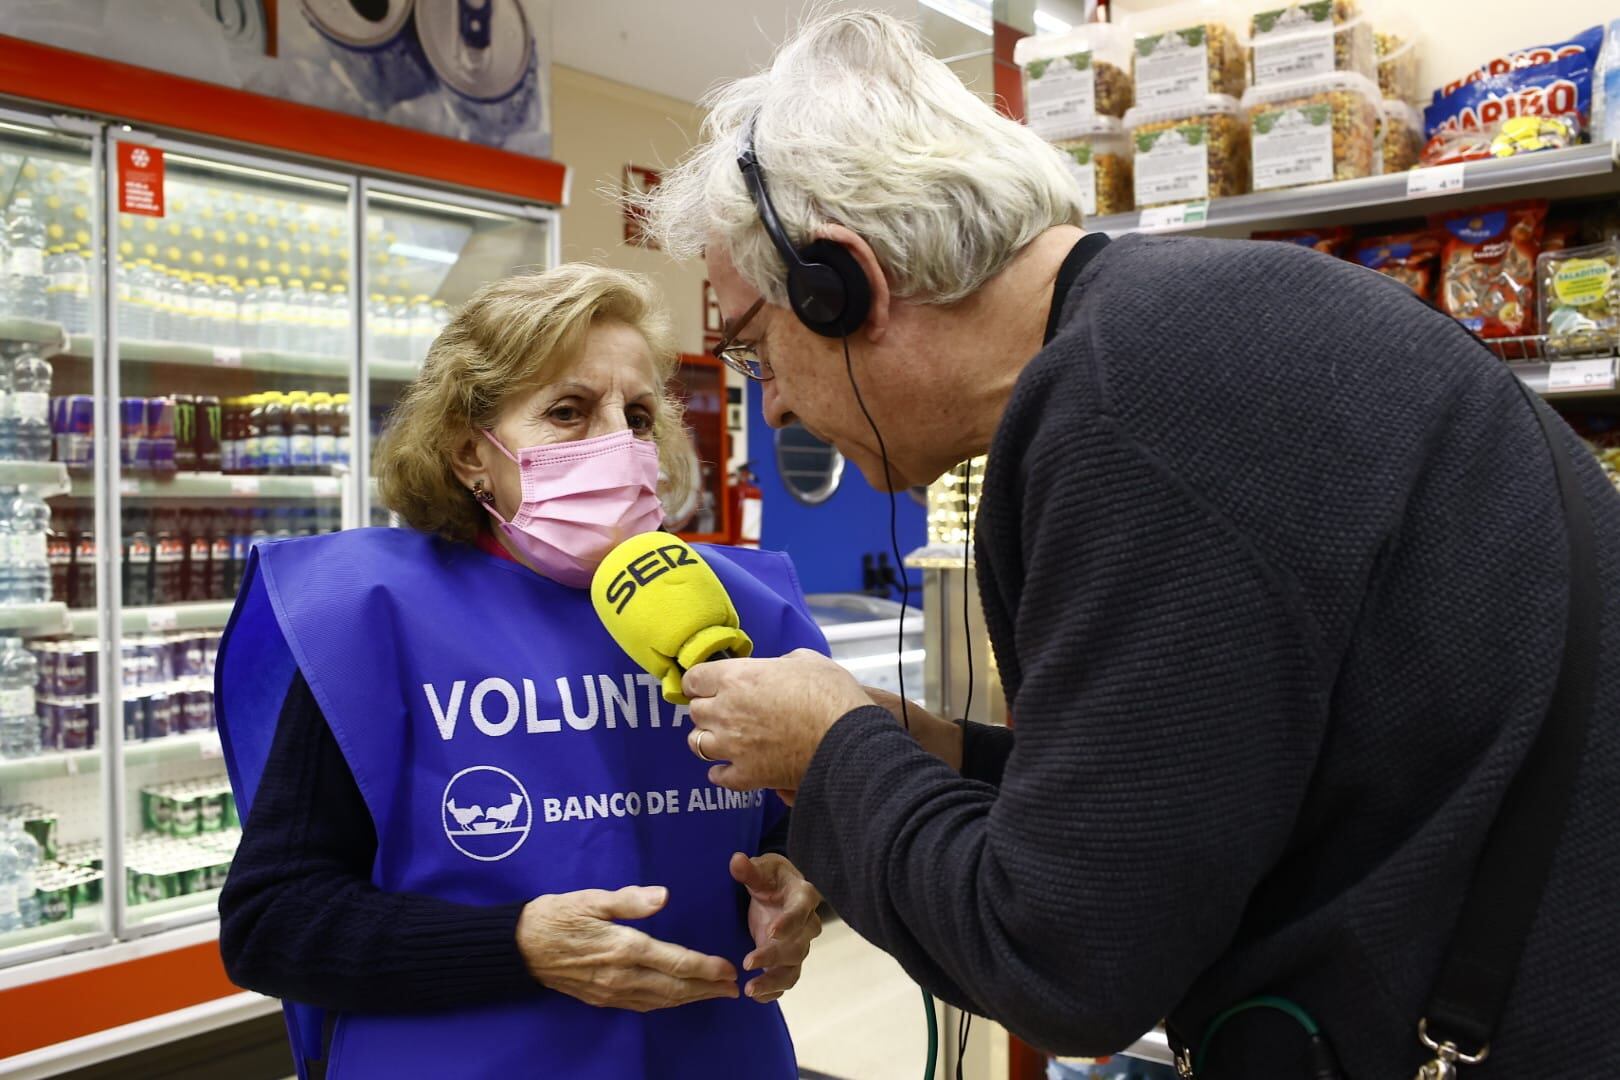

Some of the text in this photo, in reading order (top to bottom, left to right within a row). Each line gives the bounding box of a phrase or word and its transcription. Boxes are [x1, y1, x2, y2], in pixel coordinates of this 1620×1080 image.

[606, 543, 699, 615] SER
[543, 791, 641, 822] BANCO
[647, 789, 680, 815] DE
